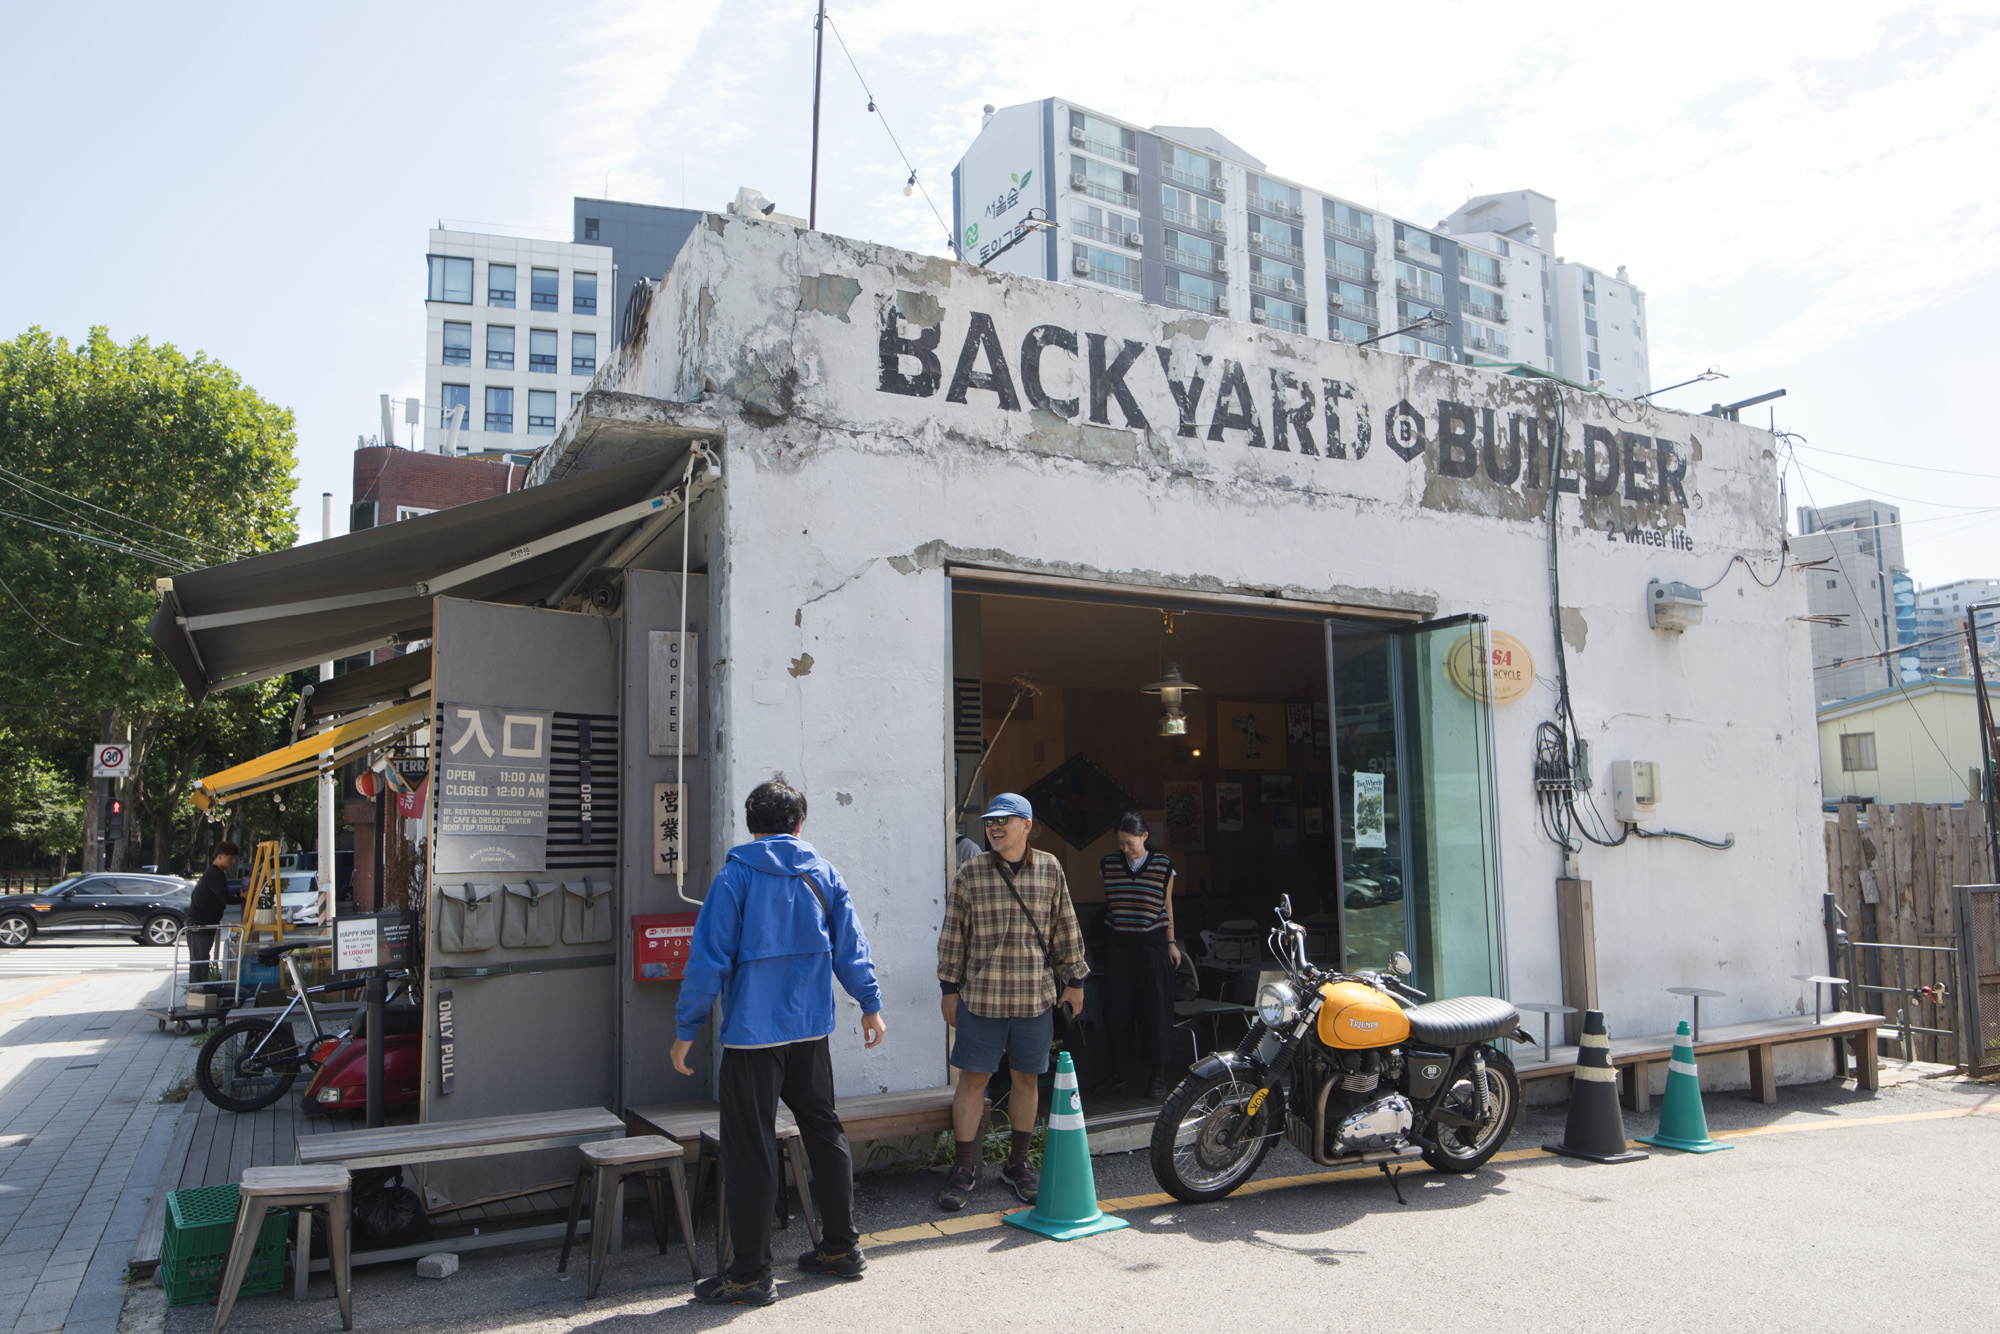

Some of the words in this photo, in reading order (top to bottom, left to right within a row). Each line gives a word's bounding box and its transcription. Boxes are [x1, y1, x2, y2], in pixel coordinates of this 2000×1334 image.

[984, 187, 1019, 220] 서울숲
[876, 300, 1372, 460] BACKYARD
[1437, 398, 1689, 508] BUILDER
[1605, 520, 1617, 542] 2
[1670, 528, 1694, 551] life
[1467, 666, 1522, 681] MORCYCLE
[669, 642, 678, 732] COFFEE
[449, 709, 543, 758] 入口
[105, 752, 118, 762] 30
[446, 770, 476, 781] OPEN
[500, 771, 525, 783] 11:00
[528, 773, 545, 783] AM
[446, 785, 488, 797] CLOSED
[496, 786, 525, 797] 12:00
[528, 788, 545, 798] AM
[580, 784, 592, 821] OPEN
[454, 808, 490, 816] RESTROOM
[491, 809, 521, 817] OUTDOOR
[453, 816, 470, 824] CAFE
[502, 817, 531, 825] COUNTER
[469, 846, 496, 860] BACKYARD
[496, 846, 516, 860] BUILDER
[340, 930, 359, 938] HAPPY
[664, 938, 692, 947] POS
[439, 1000, 453, 1038] ONLY
[441, 1043, 454, 1083] PULL
